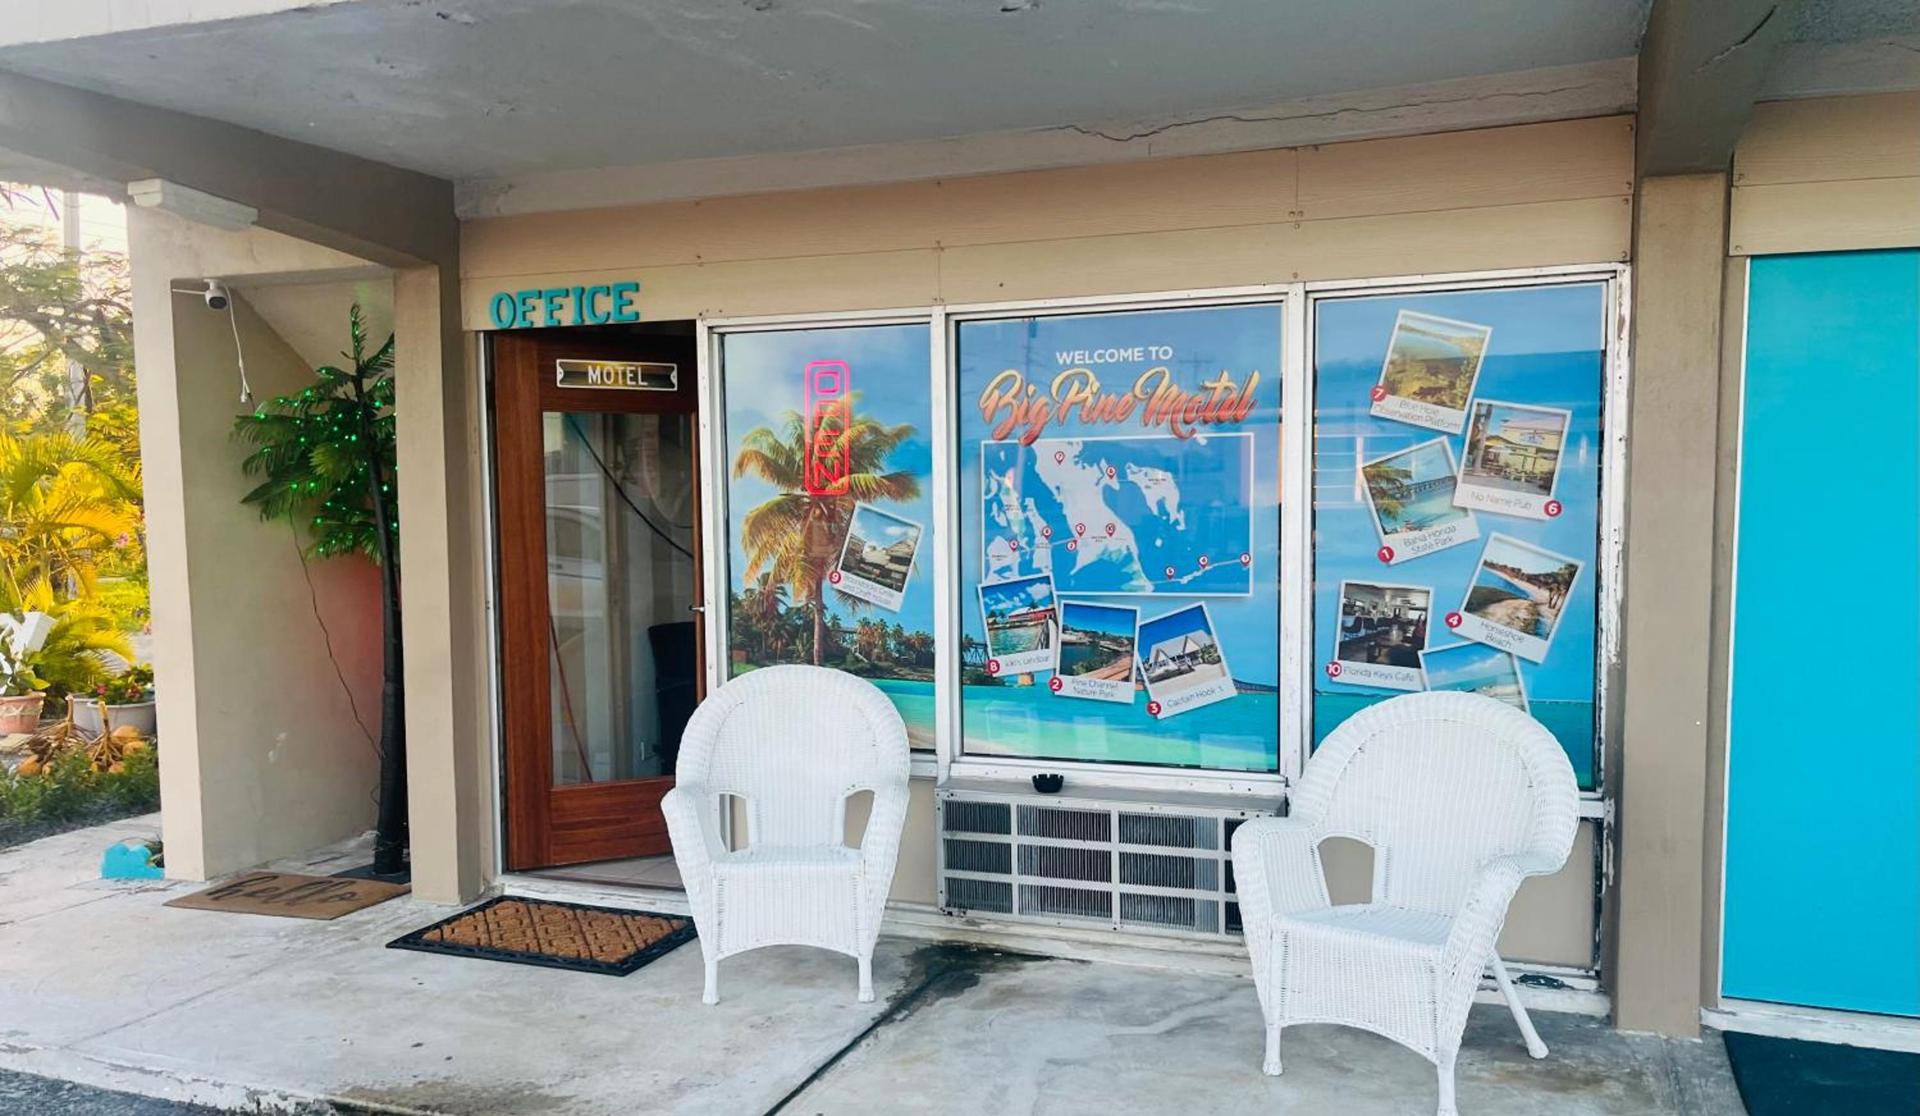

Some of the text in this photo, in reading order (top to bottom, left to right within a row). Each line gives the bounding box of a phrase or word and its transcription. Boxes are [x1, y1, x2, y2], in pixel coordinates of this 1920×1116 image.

[489, 282, 640, 329] OFFICE
[1056, 346, 1174, 365] WELCOME TO
[587, 365, 649, 387] MOTEL
[979, 366, 1261, 446] Big Pine Motel
[814, 370, 841, 486] OPEN
[1485, 632, 1512, 649] Beach
